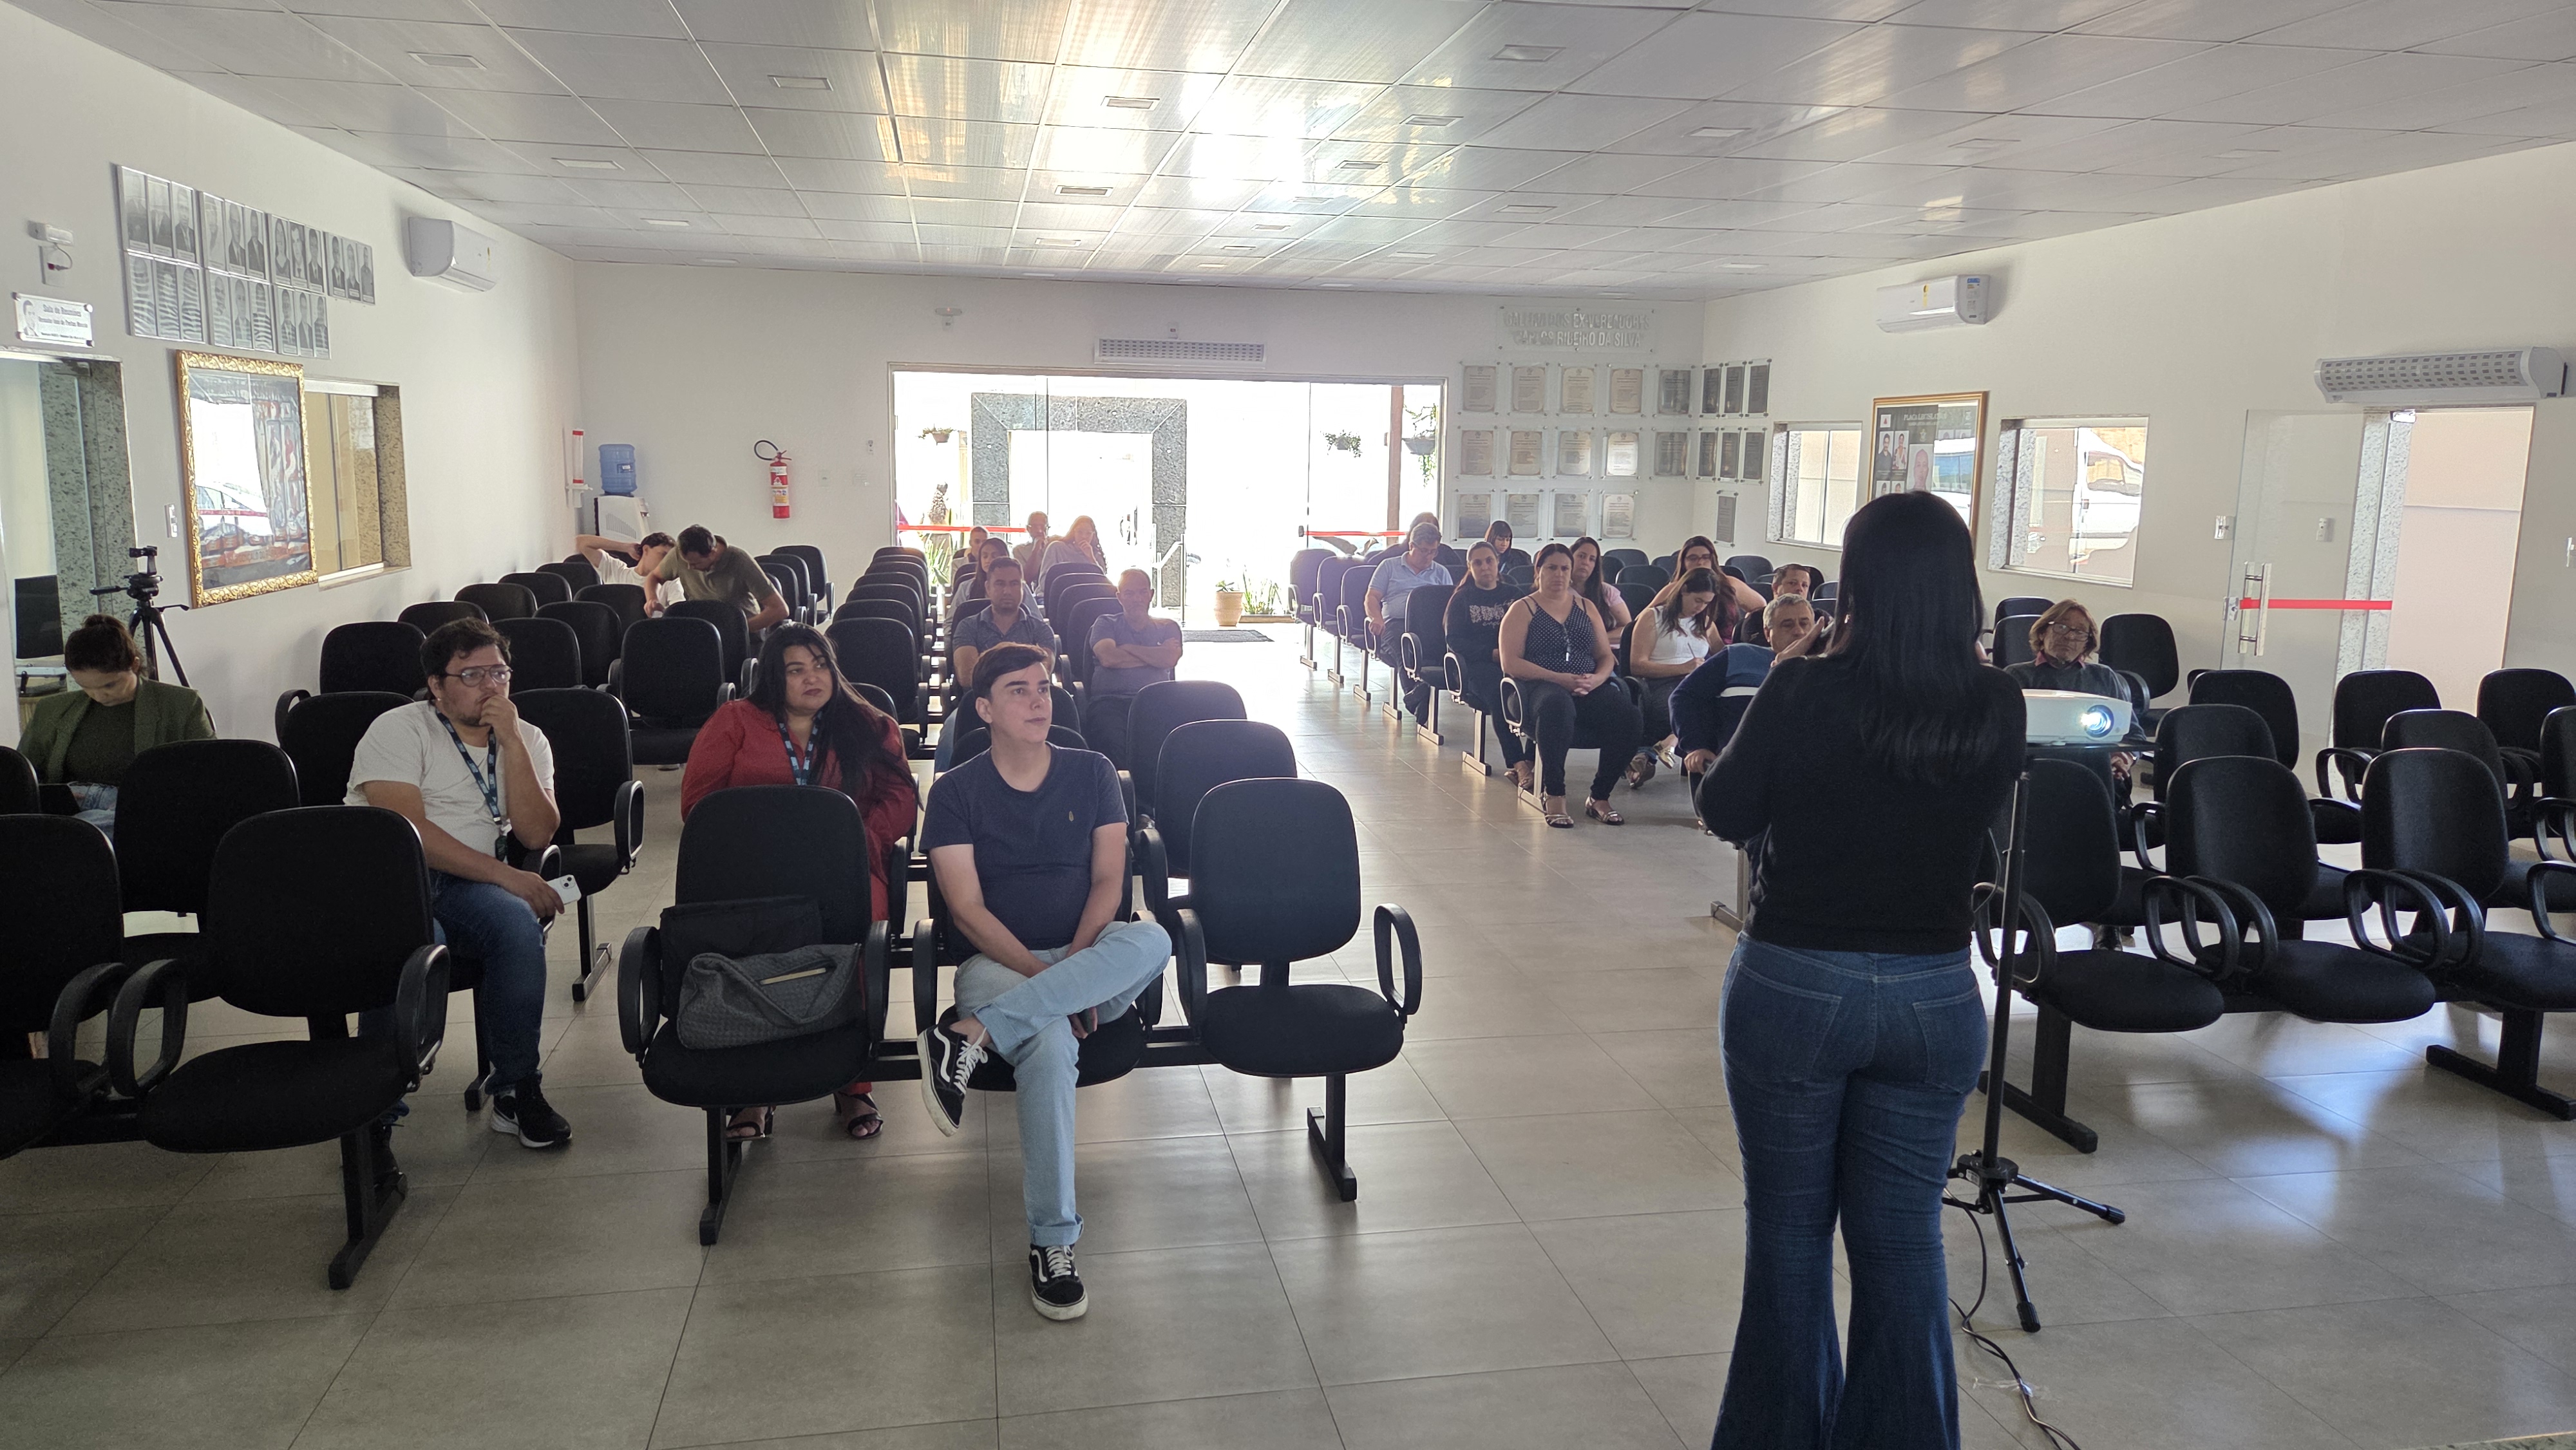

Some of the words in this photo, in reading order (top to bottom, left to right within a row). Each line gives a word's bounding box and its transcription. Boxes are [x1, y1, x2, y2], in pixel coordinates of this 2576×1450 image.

[1557, 330, 1596, 346] RIBEIRO
[1598, 332, 1611, 347] DA
[1614, 332, 1641, 348] SILVA
